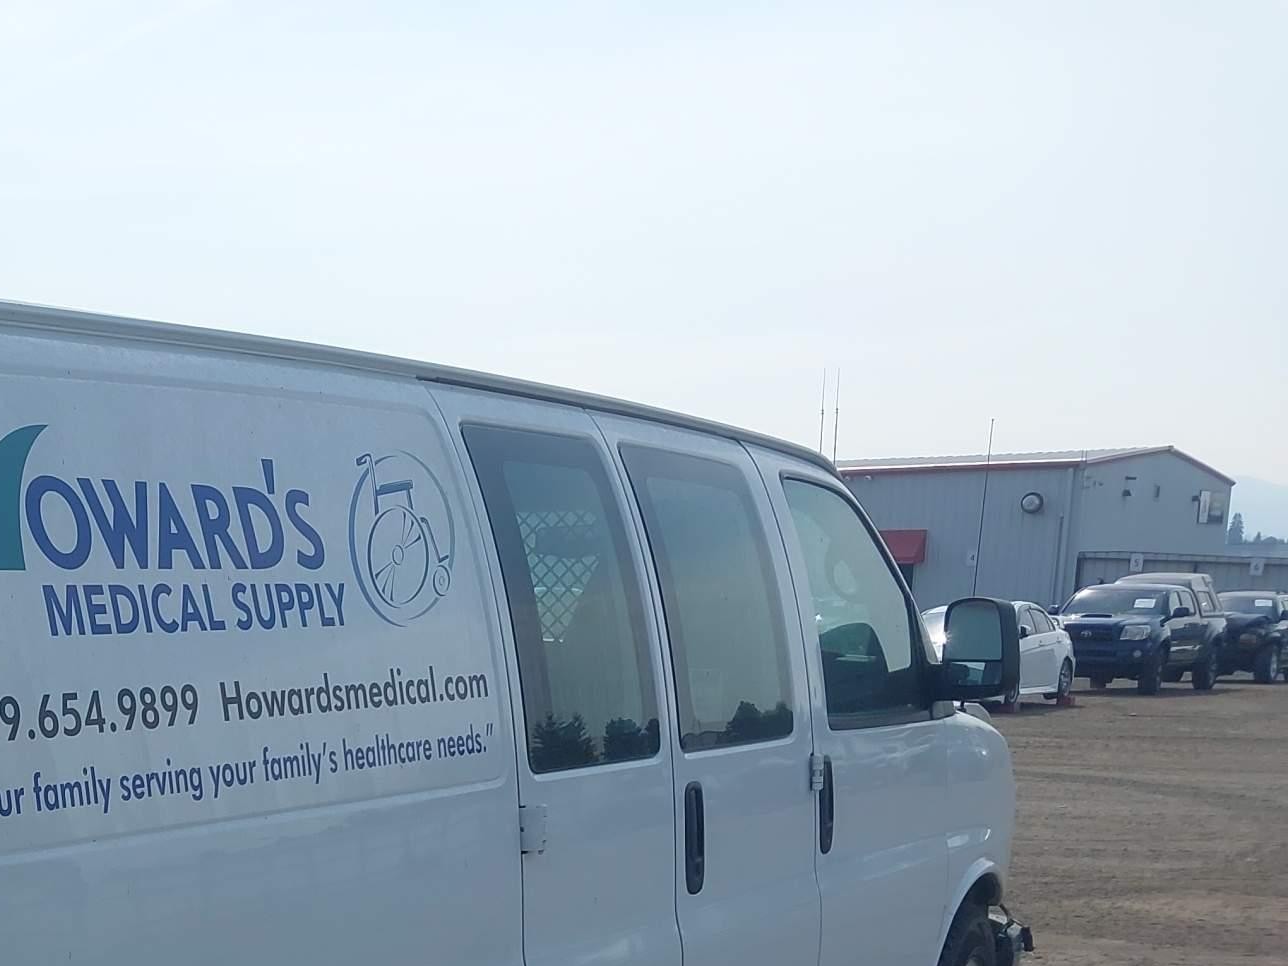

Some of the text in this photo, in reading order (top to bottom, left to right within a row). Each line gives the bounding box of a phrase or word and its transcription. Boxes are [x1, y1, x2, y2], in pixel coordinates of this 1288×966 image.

[42, 582, 345, 637] MEDICAL SUPPLY
[219, 665, 489, 723] Howardsmedical.com
[33, 766, 111, 814] family
[120, 758, 203, 800] serving
[209, 759, 257, 799] your
[343, 732, 432, 780] healthcare
